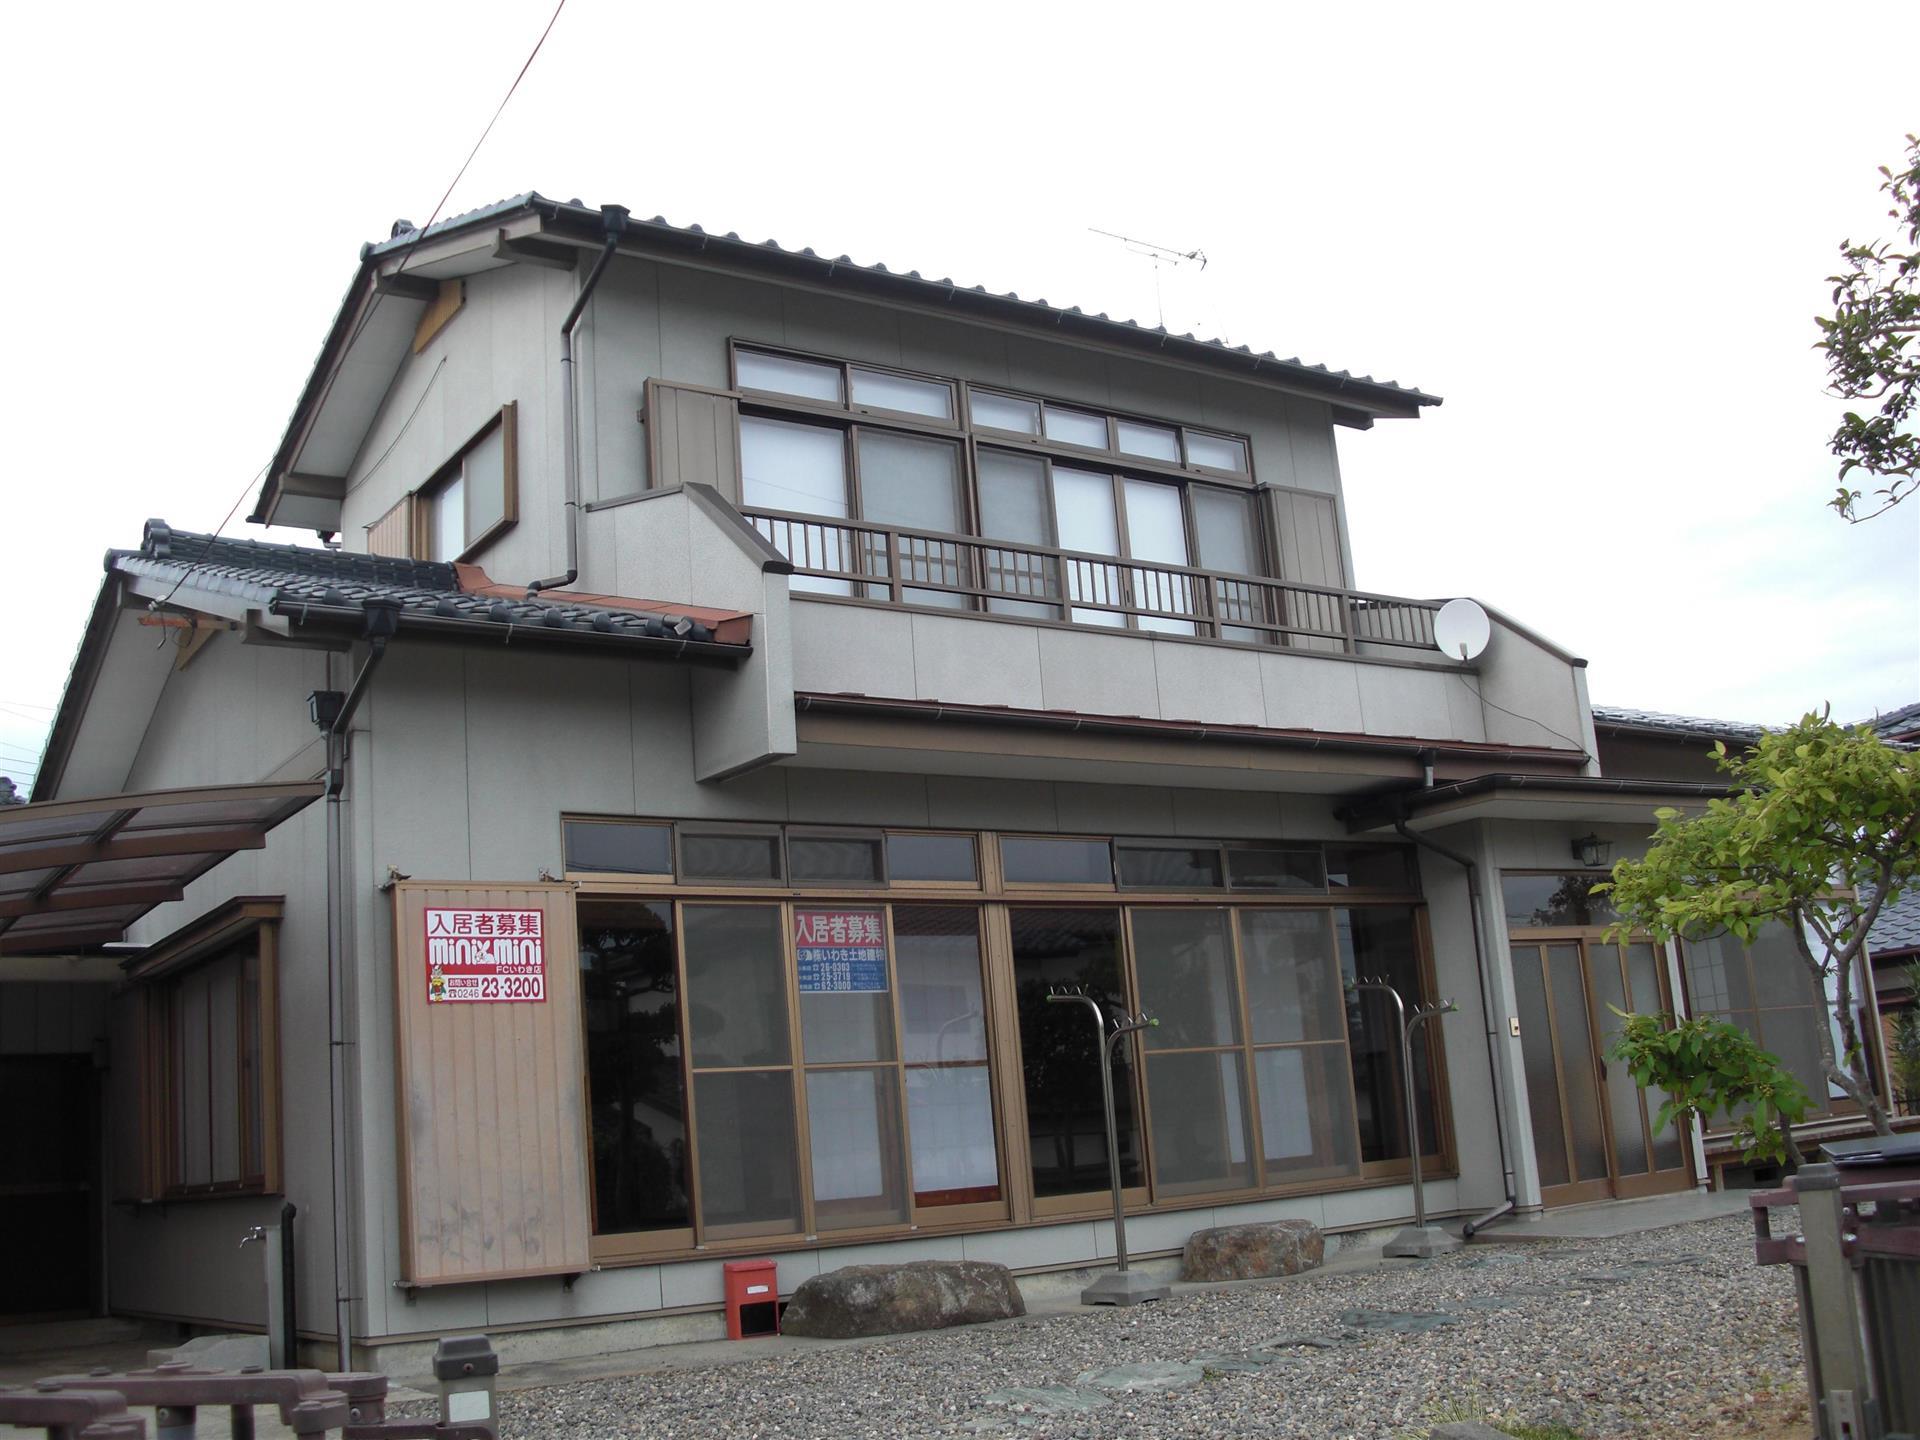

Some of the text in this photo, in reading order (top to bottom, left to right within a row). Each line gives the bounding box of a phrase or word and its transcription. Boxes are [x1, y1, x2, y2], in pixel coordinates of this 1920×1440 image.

[430, 913, 539, 935] 入居者募集
[795, 915, 882, 944] 入居者募集
[496, 965, 542, 974] FCいわき店
[457, 977, 541, 998] 0246 23-3200
